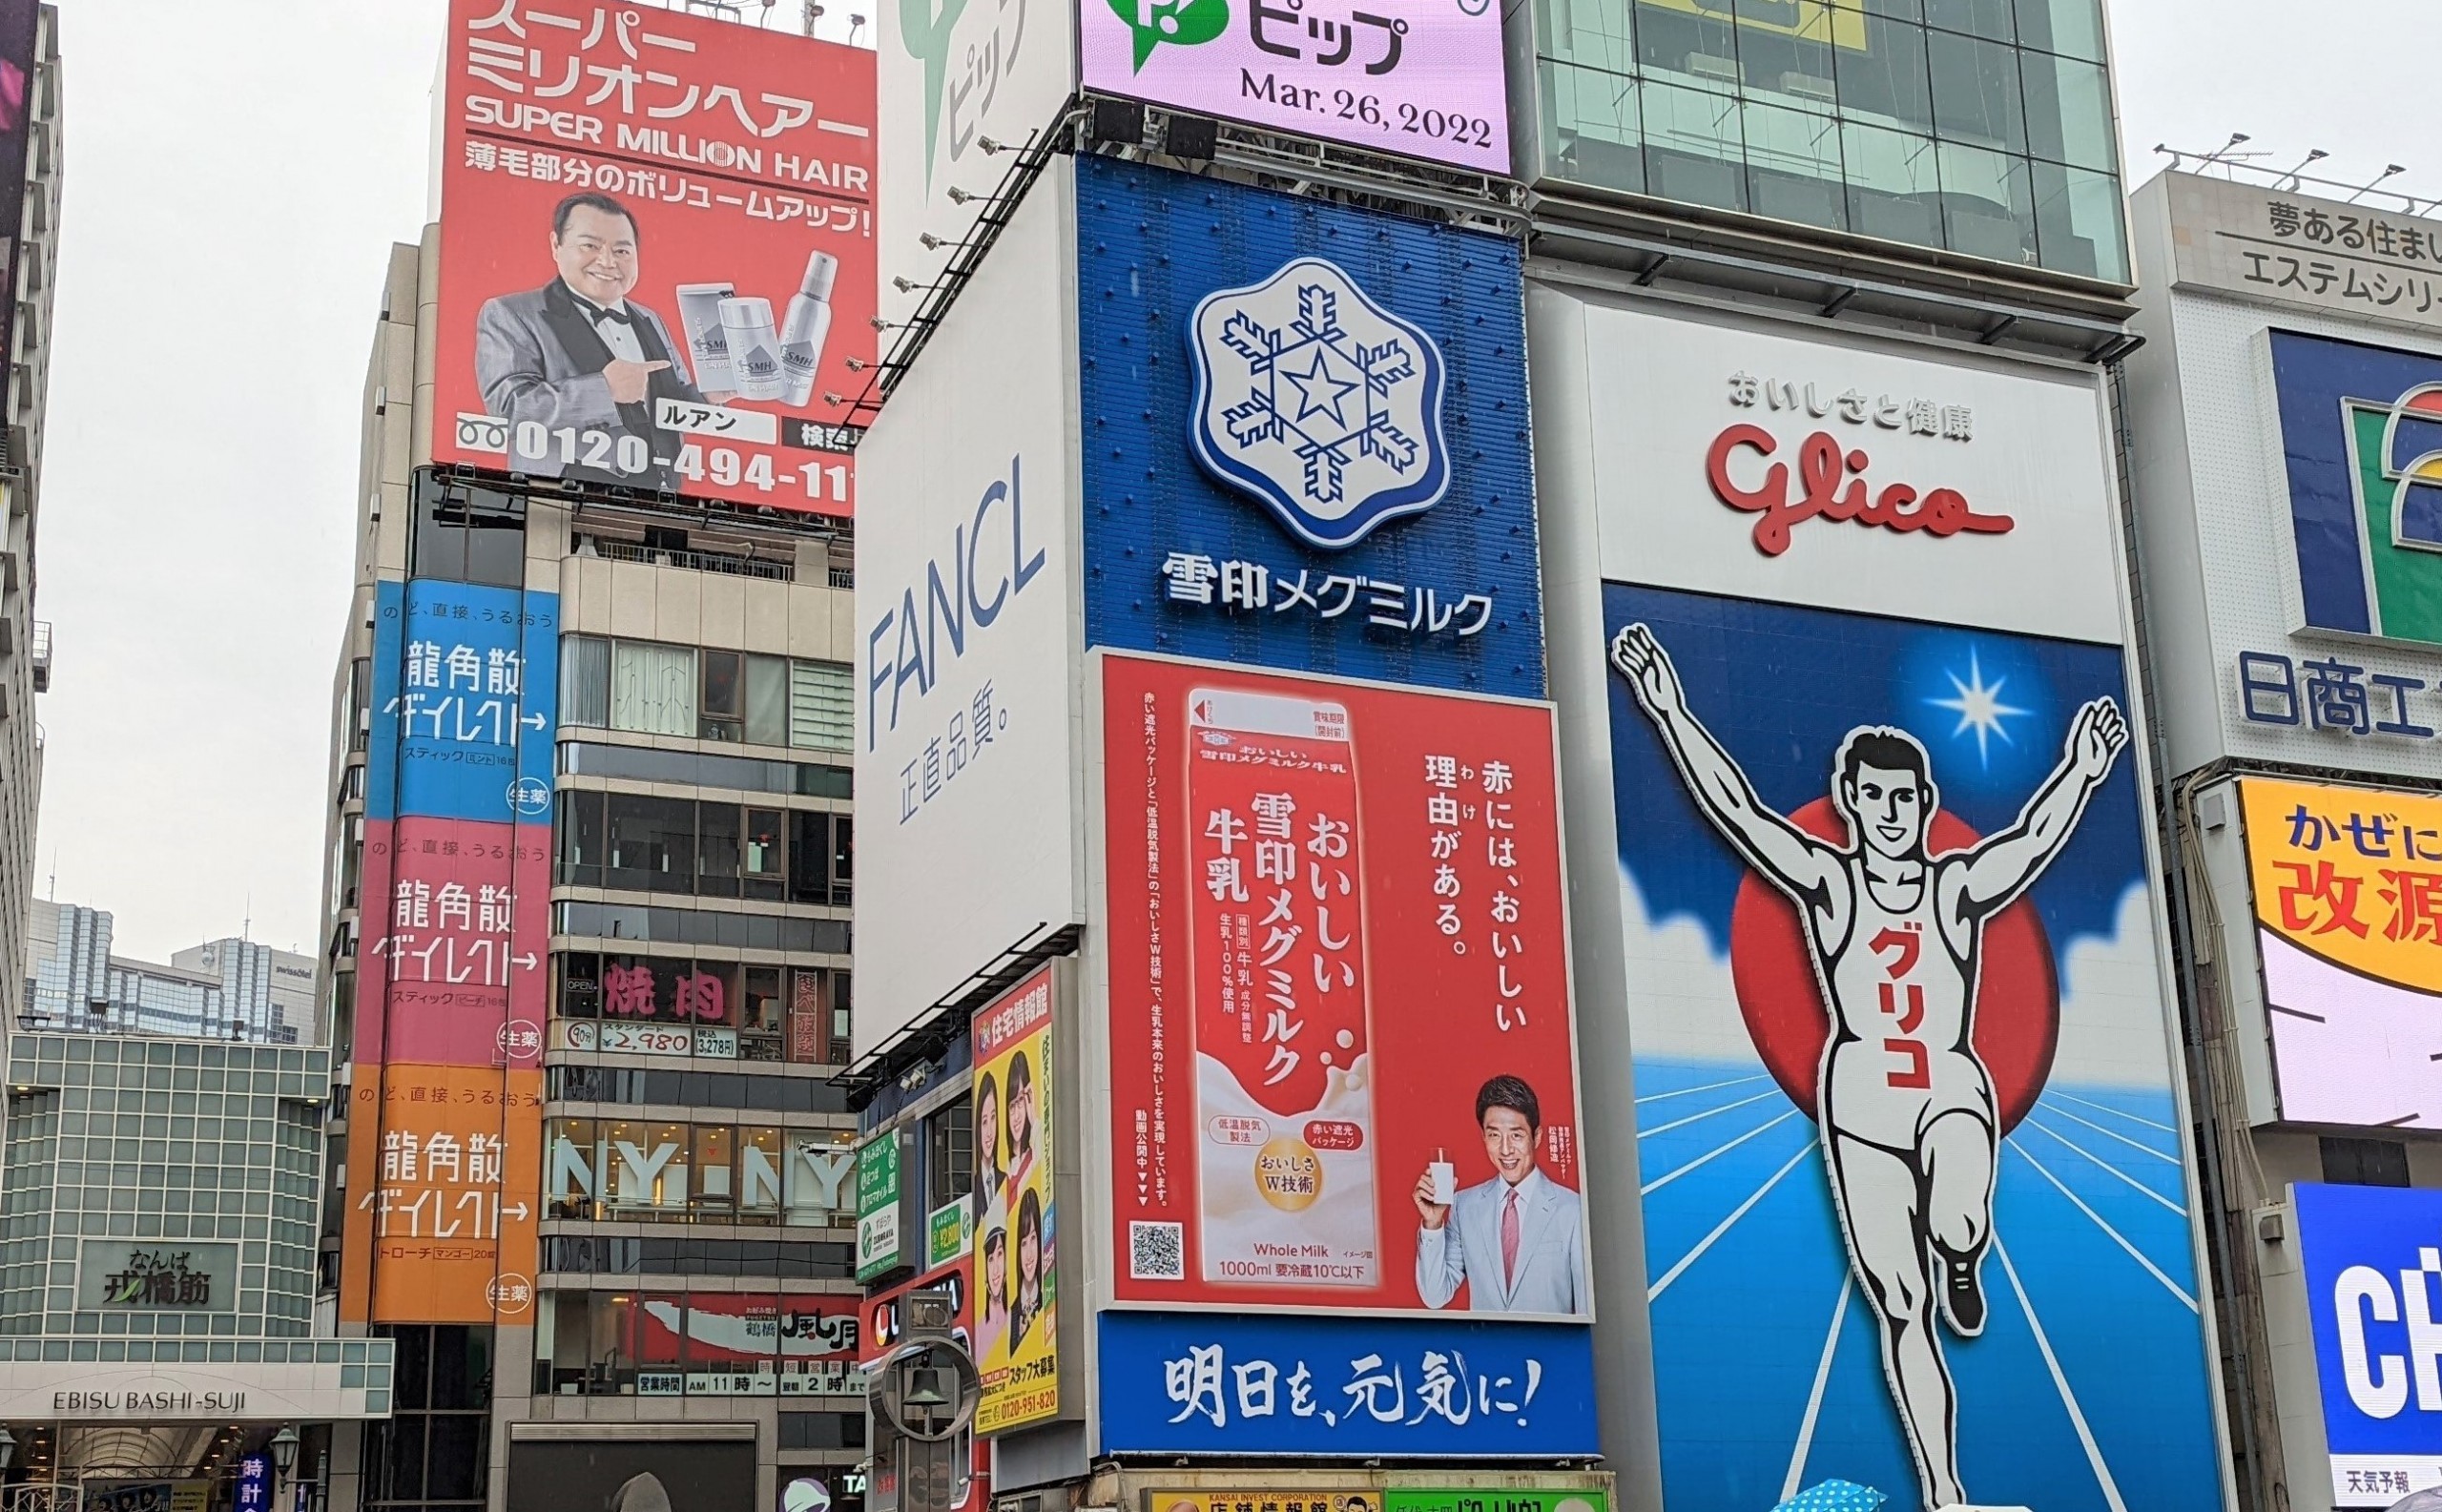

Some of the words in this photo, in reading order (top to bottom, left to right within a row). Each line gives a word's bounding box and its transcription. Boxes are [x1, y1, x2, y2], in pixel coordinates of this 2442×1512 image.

[467, 0, 696, 60] スーパー
[1251, 0, 1409, 75] ピップ
[467, 37, 869, 138] ミリオンヘアー
[1241, 68, 1326, 114] Mar.
[1335, 89, 1391, 131] 26,
[1398, 102, 1492, 149] 2022
[466, 95, 603, 144] SUPER
[617, 122, 762, 175] MILLION
[775, 154, 869, 192] HAIR
[2243, 251, 2442, 313] エステムシリ
[664, 404, 737, 432] ルアン
[1728, 370, 1974, 443] おいしさと健康
[515, 421, 855, 503] 0120-494-11
[1706, 424, 2016, 558] Glico
[869, 452, 1045, 754] FANCL
[1162, 550, 1493, 636] 雪印メグミルク
[407, 640, 527, 696] 龍角散
[2239, 650, 2442, 737] 日商エ
[383, 693, 548, 748] ダイレクト
[1199, 750, 1347, 774] 雪印メグミルク牛乳
[1204, 808, 1250, 902] 牛乳
[1424, 755, 1466, 955] 理由がある。
[397, 879, 518, 934] 龍角散
[1307, 813, 1355, 993] おいしい
[1481, 760, 1527, 1032] 赤には、おいしい
[371, 934, 538, 987] ダイレクト
[1251, 792, 1304, 1087] 雪印メグミルク
[567, 981, 593, 990] OPEN
[604, 963, 725, 1020] 焼肉
[1236, 952, 1253, 987] 牛乳
[1868, 921, 1932, 1089] グリコ
[1218, 1118, 1262, 1131] 低温脱気
[1229, 1130, 1252, 1143] 製法
[1312, 1136, 1355, 1148] パッケージ
[383, 1129, 508, 1184] 龍角散
[1260, 1156, 1315, 1171] おいしさ
[1265, 1175, 1314, 1193] W技術
[358, 1189, 528, 1239] ダイレクト
[129, 1249, 191, 1270] なんば
[1219, 1261, 1272, 1276] 1000ml
[1253, 1243, 1298, 1257] Whole
[1301, 1245, 1329, 1257] Milk
[781, 1308, 859, 1352] 風月
[53, 1391, 120, 1411] EBISU
[640, 1376, 681, 1393] 営業時間
[1164, 1343, 1542, 1428] 明日を、元気に!
[241, 1458, 264, 1512] 時計
[1209, 1493, 1238, 1502] KANSAI
[1240, 1493, 1269, 1502] INVEST
[1272, 1493, 1328, 1502] CORPORATION
[2346, 1470, 2411, 1494] 天気予報
